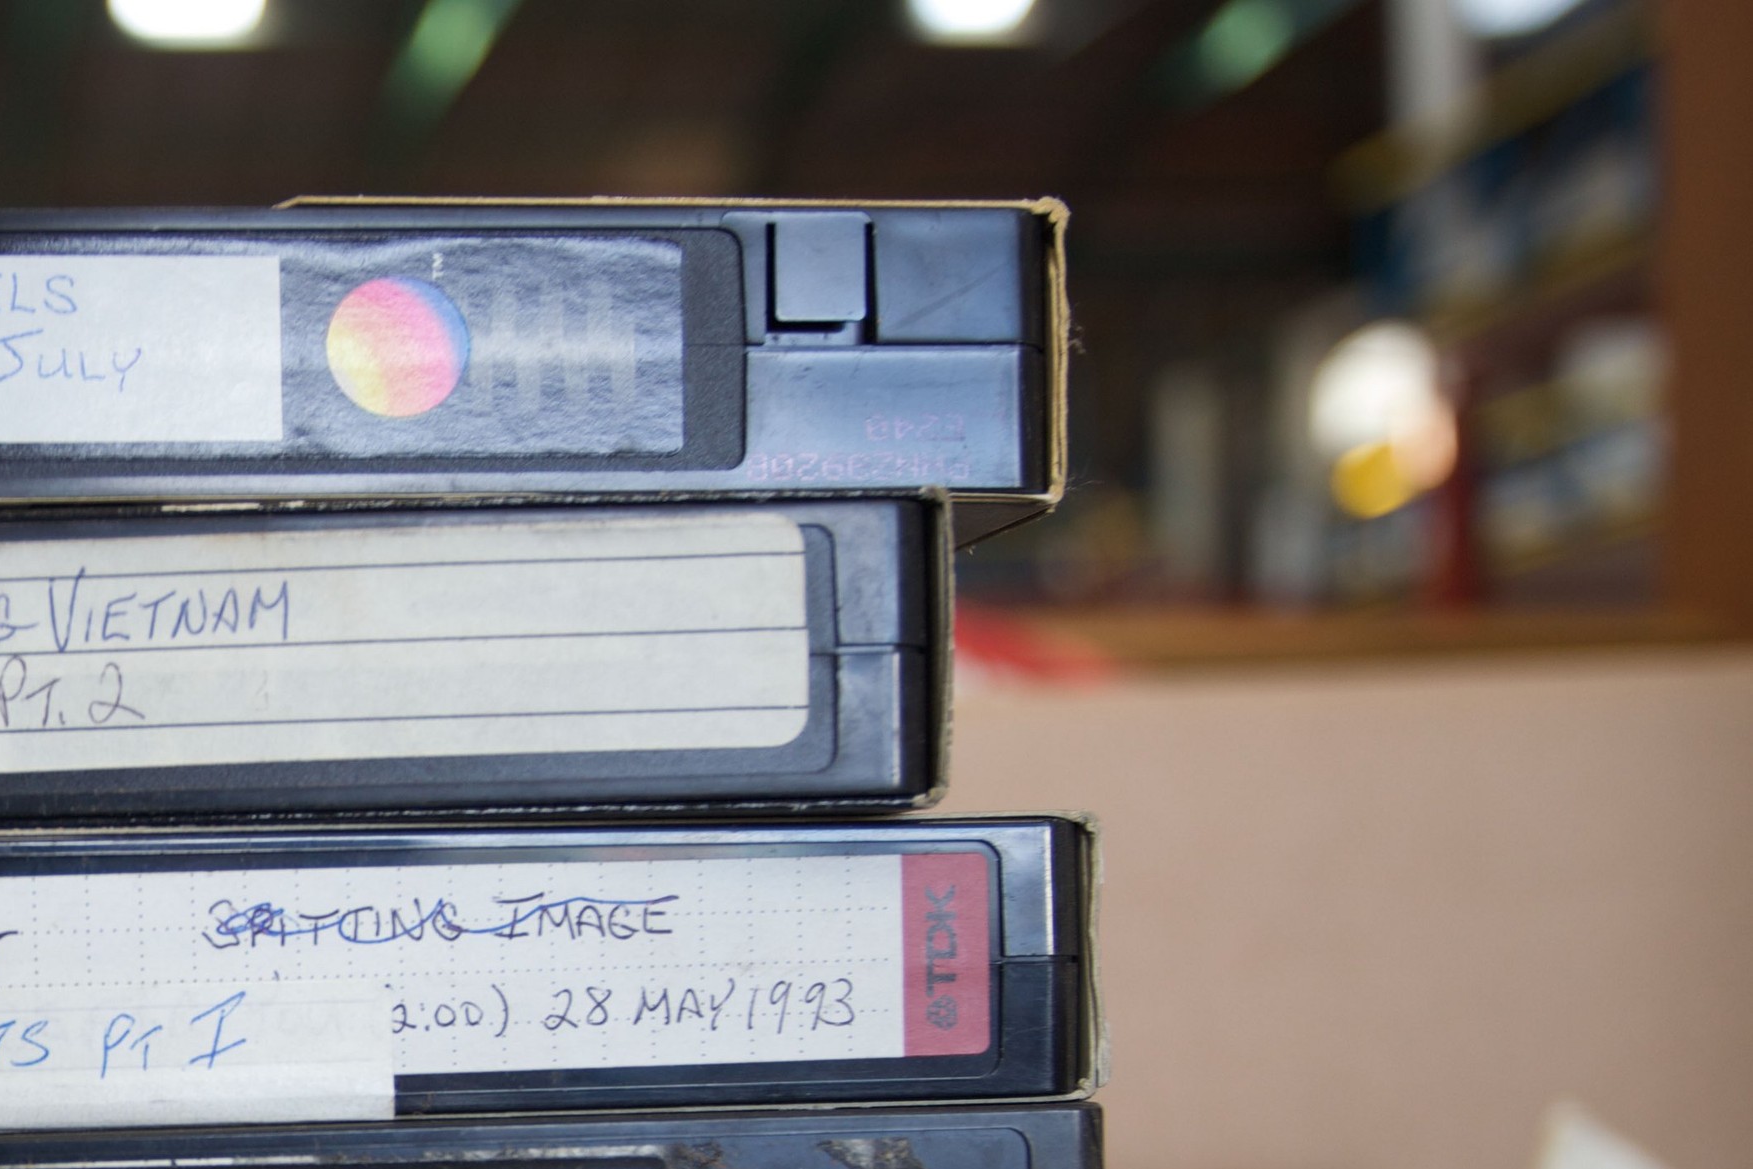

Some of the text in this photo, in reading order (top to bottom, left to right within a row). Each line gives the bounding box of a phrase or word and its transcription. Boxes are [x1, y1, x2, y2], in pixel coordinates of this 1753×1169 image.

[48, 567, 291, 654] VIETNAM
[924, 884, 958, 998] TDK
[545, 988, 610, 1030] 28
[632, 977, 736, 1033] MAY
[745, 976, 857, 1035] 1993
